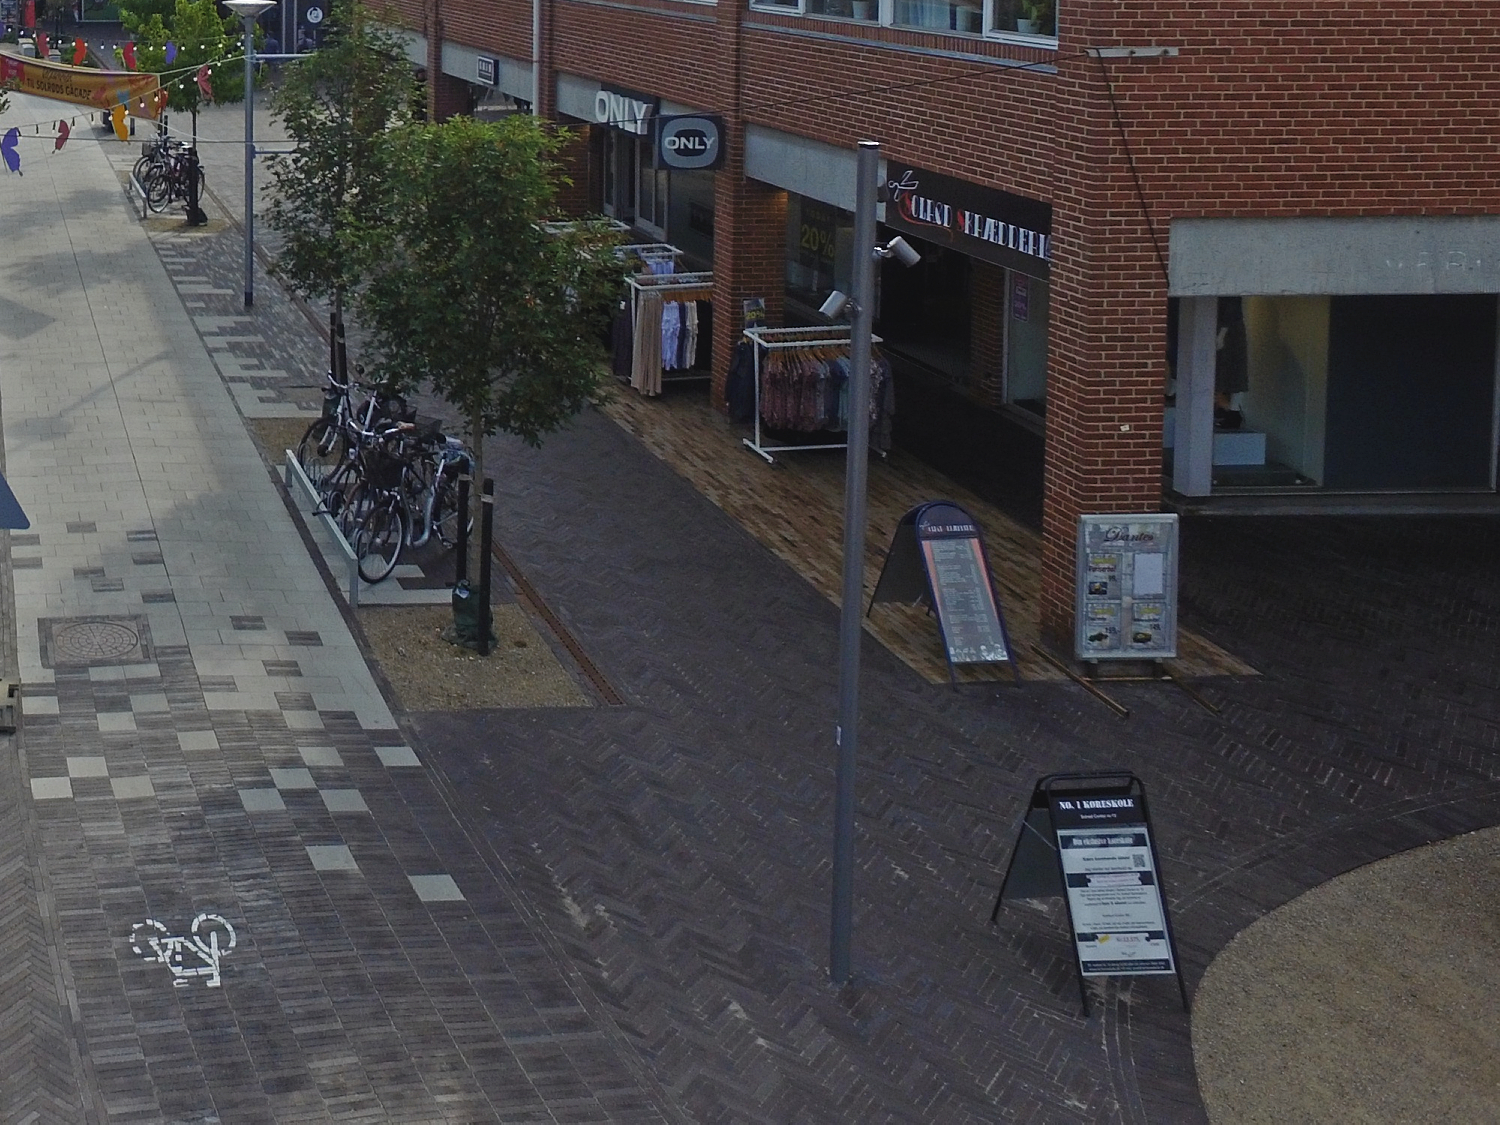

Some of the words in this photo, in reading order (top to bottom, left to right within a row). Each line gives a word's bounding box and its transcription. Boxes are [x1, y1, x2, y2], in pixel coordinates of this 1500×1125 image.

[595, 90, 653, 135] ONLY
[664, 136, 715, 150] ONLY
[801, 224, 835, 258] 20%
[1059, 801, 1075, 811] NO.
